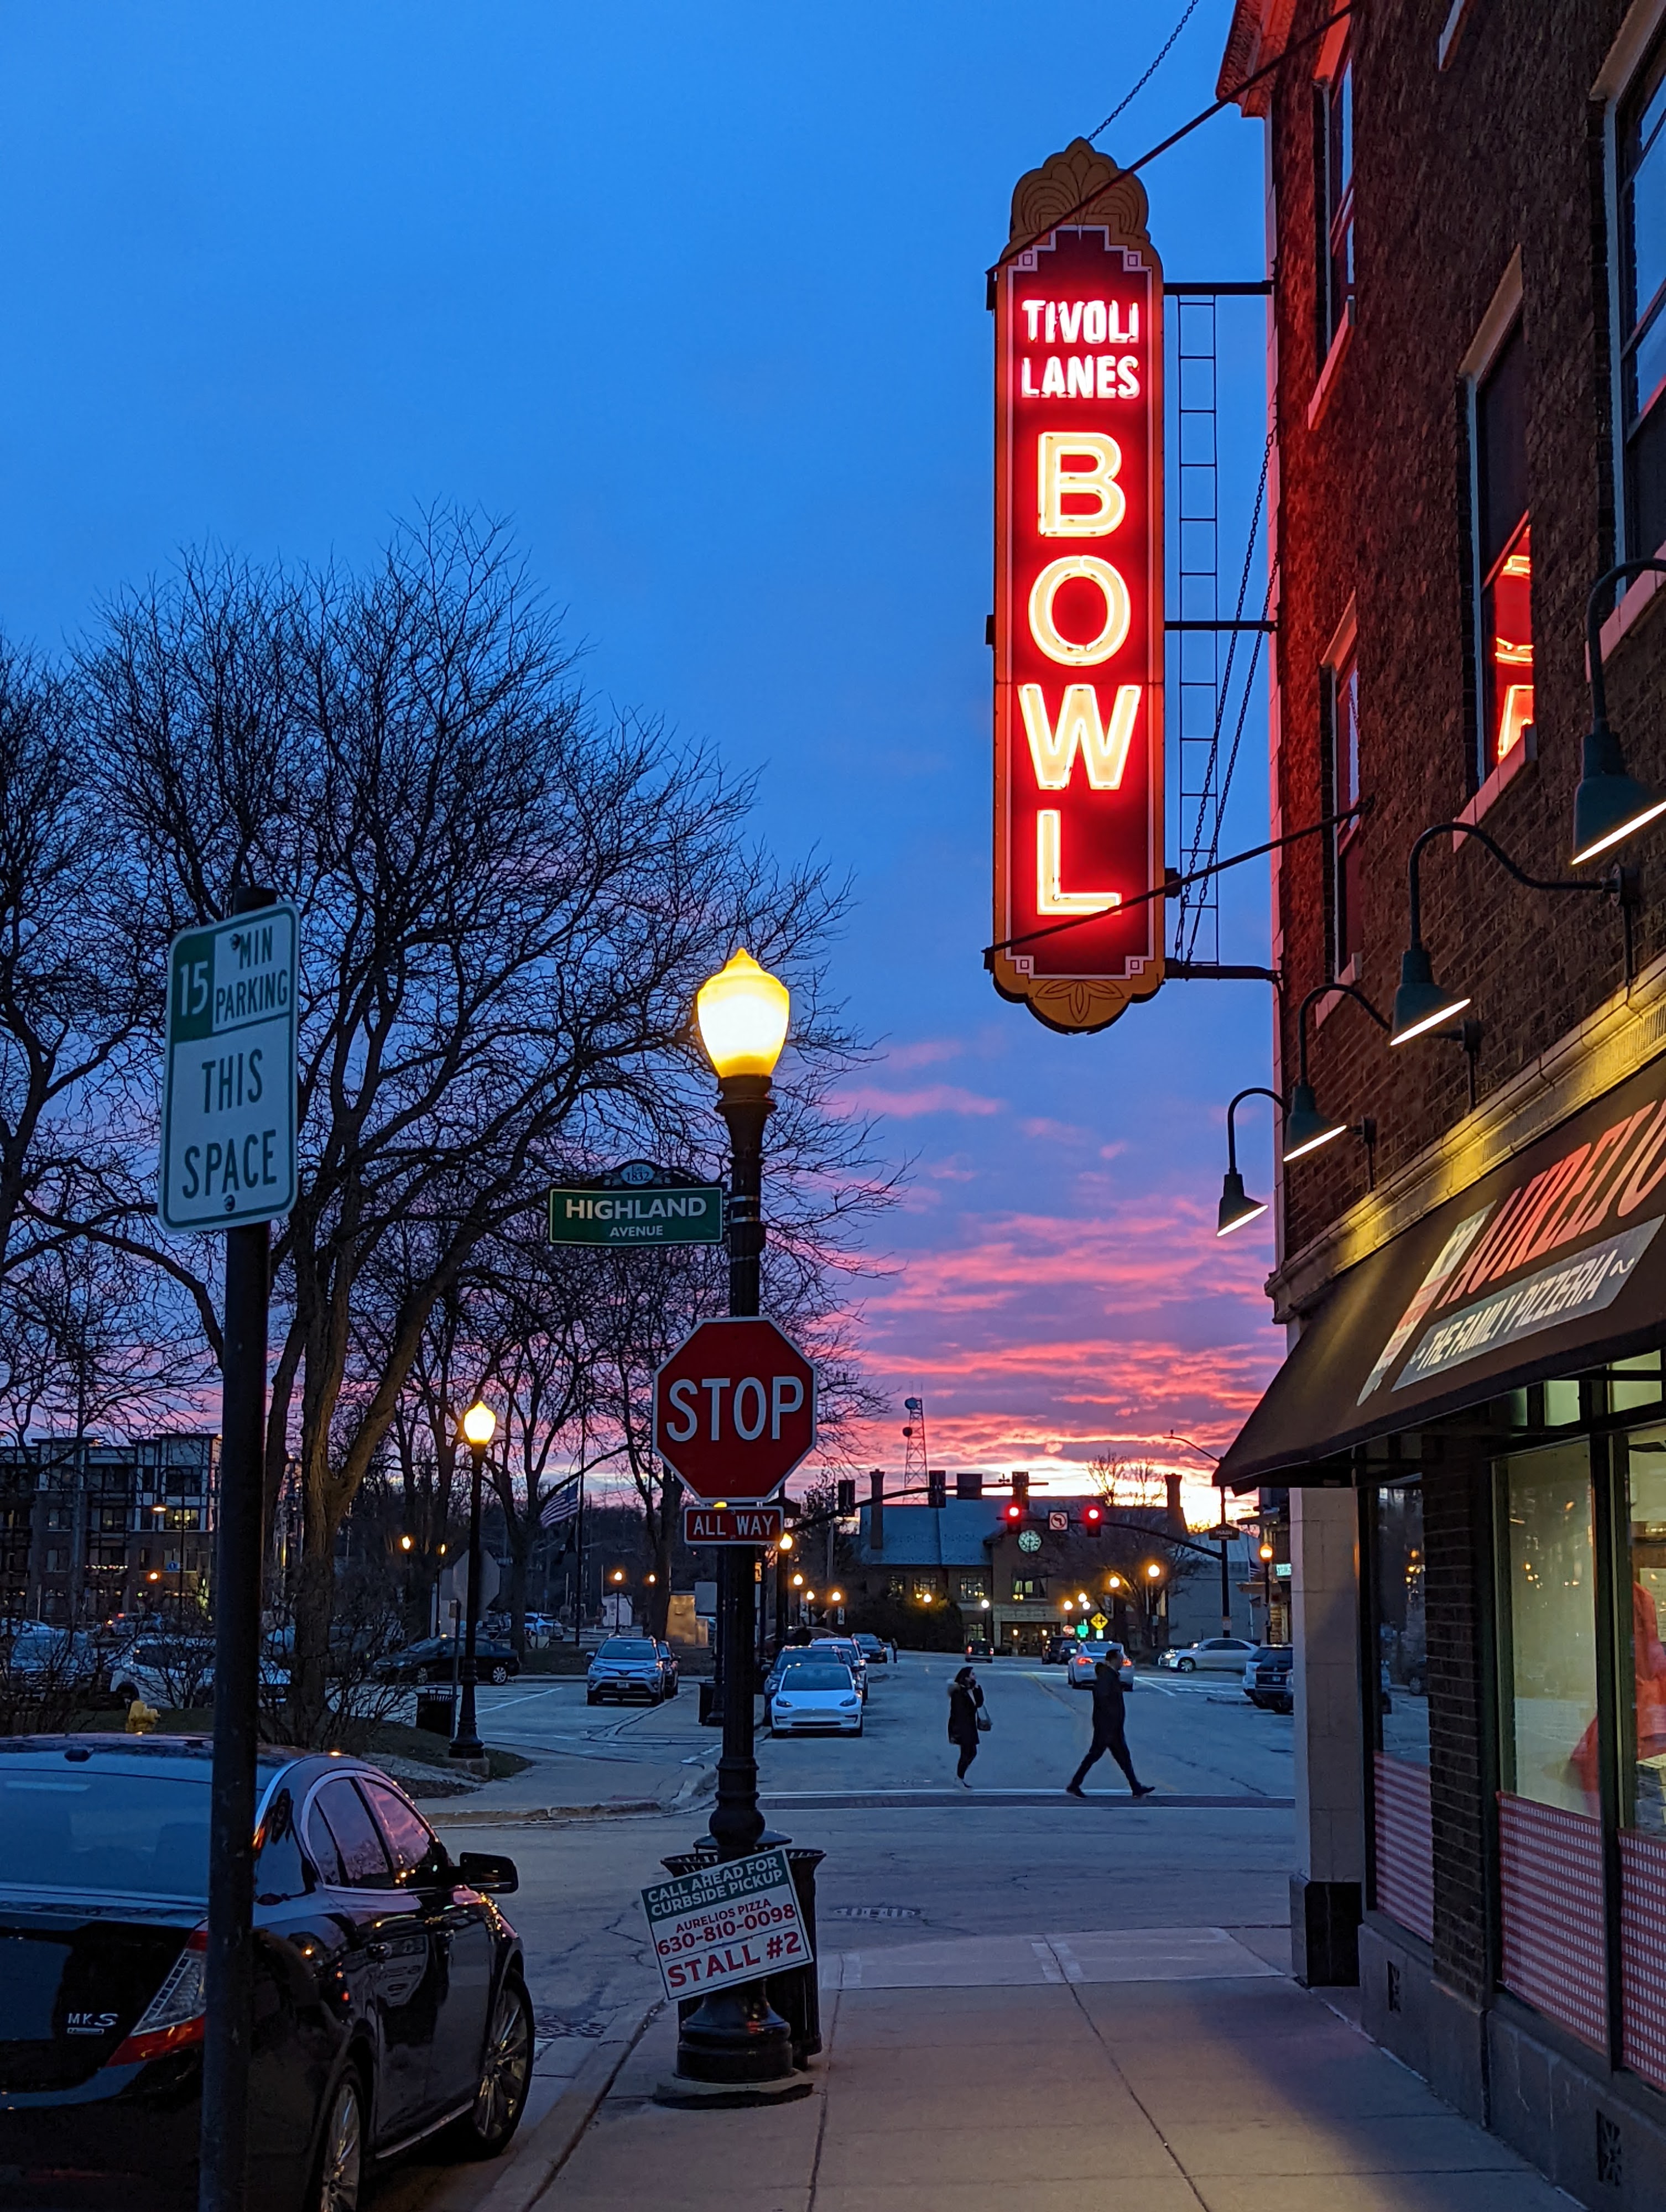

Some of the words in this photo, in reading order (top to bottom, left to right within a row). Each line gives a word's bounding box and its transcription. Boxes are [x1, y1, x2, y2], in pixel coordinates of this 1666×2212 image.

[1022, 300, 1139, 344] TIVOLI
[1022, 354, 1140, 399] LANES
[1017, 432, 1142, 916] BOWL
[179, 960, 209, 1016] 15
[239, 926, 273, 969] MIN
[215, 969, 289, 1024] PARKING
[201, 1048, 263, 1113] THIS
[182, 1129, 277, 1199] SPACE
[626, 1171, 649, 1181] 1832
[566, 1197, 707, 1219] HIGHLAND
[610, 1225, 663, 1237] AVENUE
[1417, 1321, 1462, 1371] THE
[1444, 1291, 1524, 1359] FAMILY
[1515, 1249, 1618, 1328] PIZZERIA
[667, 1376, 804, 1442] STOP
[693, 1515, 726, 1536] ALL
[737, 1515, 774, 1536] WAY
[648, 1883, 688, 1903] CALL
[691, 1866, 744, 1891] AHEAD
[746, 1856, 779, 1875] FOR
[651, 1885, 727, 1917] CURBSIDE
[730, 1869, 783, 1894] PICKUP
[658, 1904, 796, 1955] 630-810-0098
[676, 1908, 736, 1933] AURELIOS
[739, 1898, 772, 1915] PIZZA
[668, 1945, 761, 1987] STALL
[767, 1931, 801, 1959] #2
[67, 2013, 119, 2027] MKS
